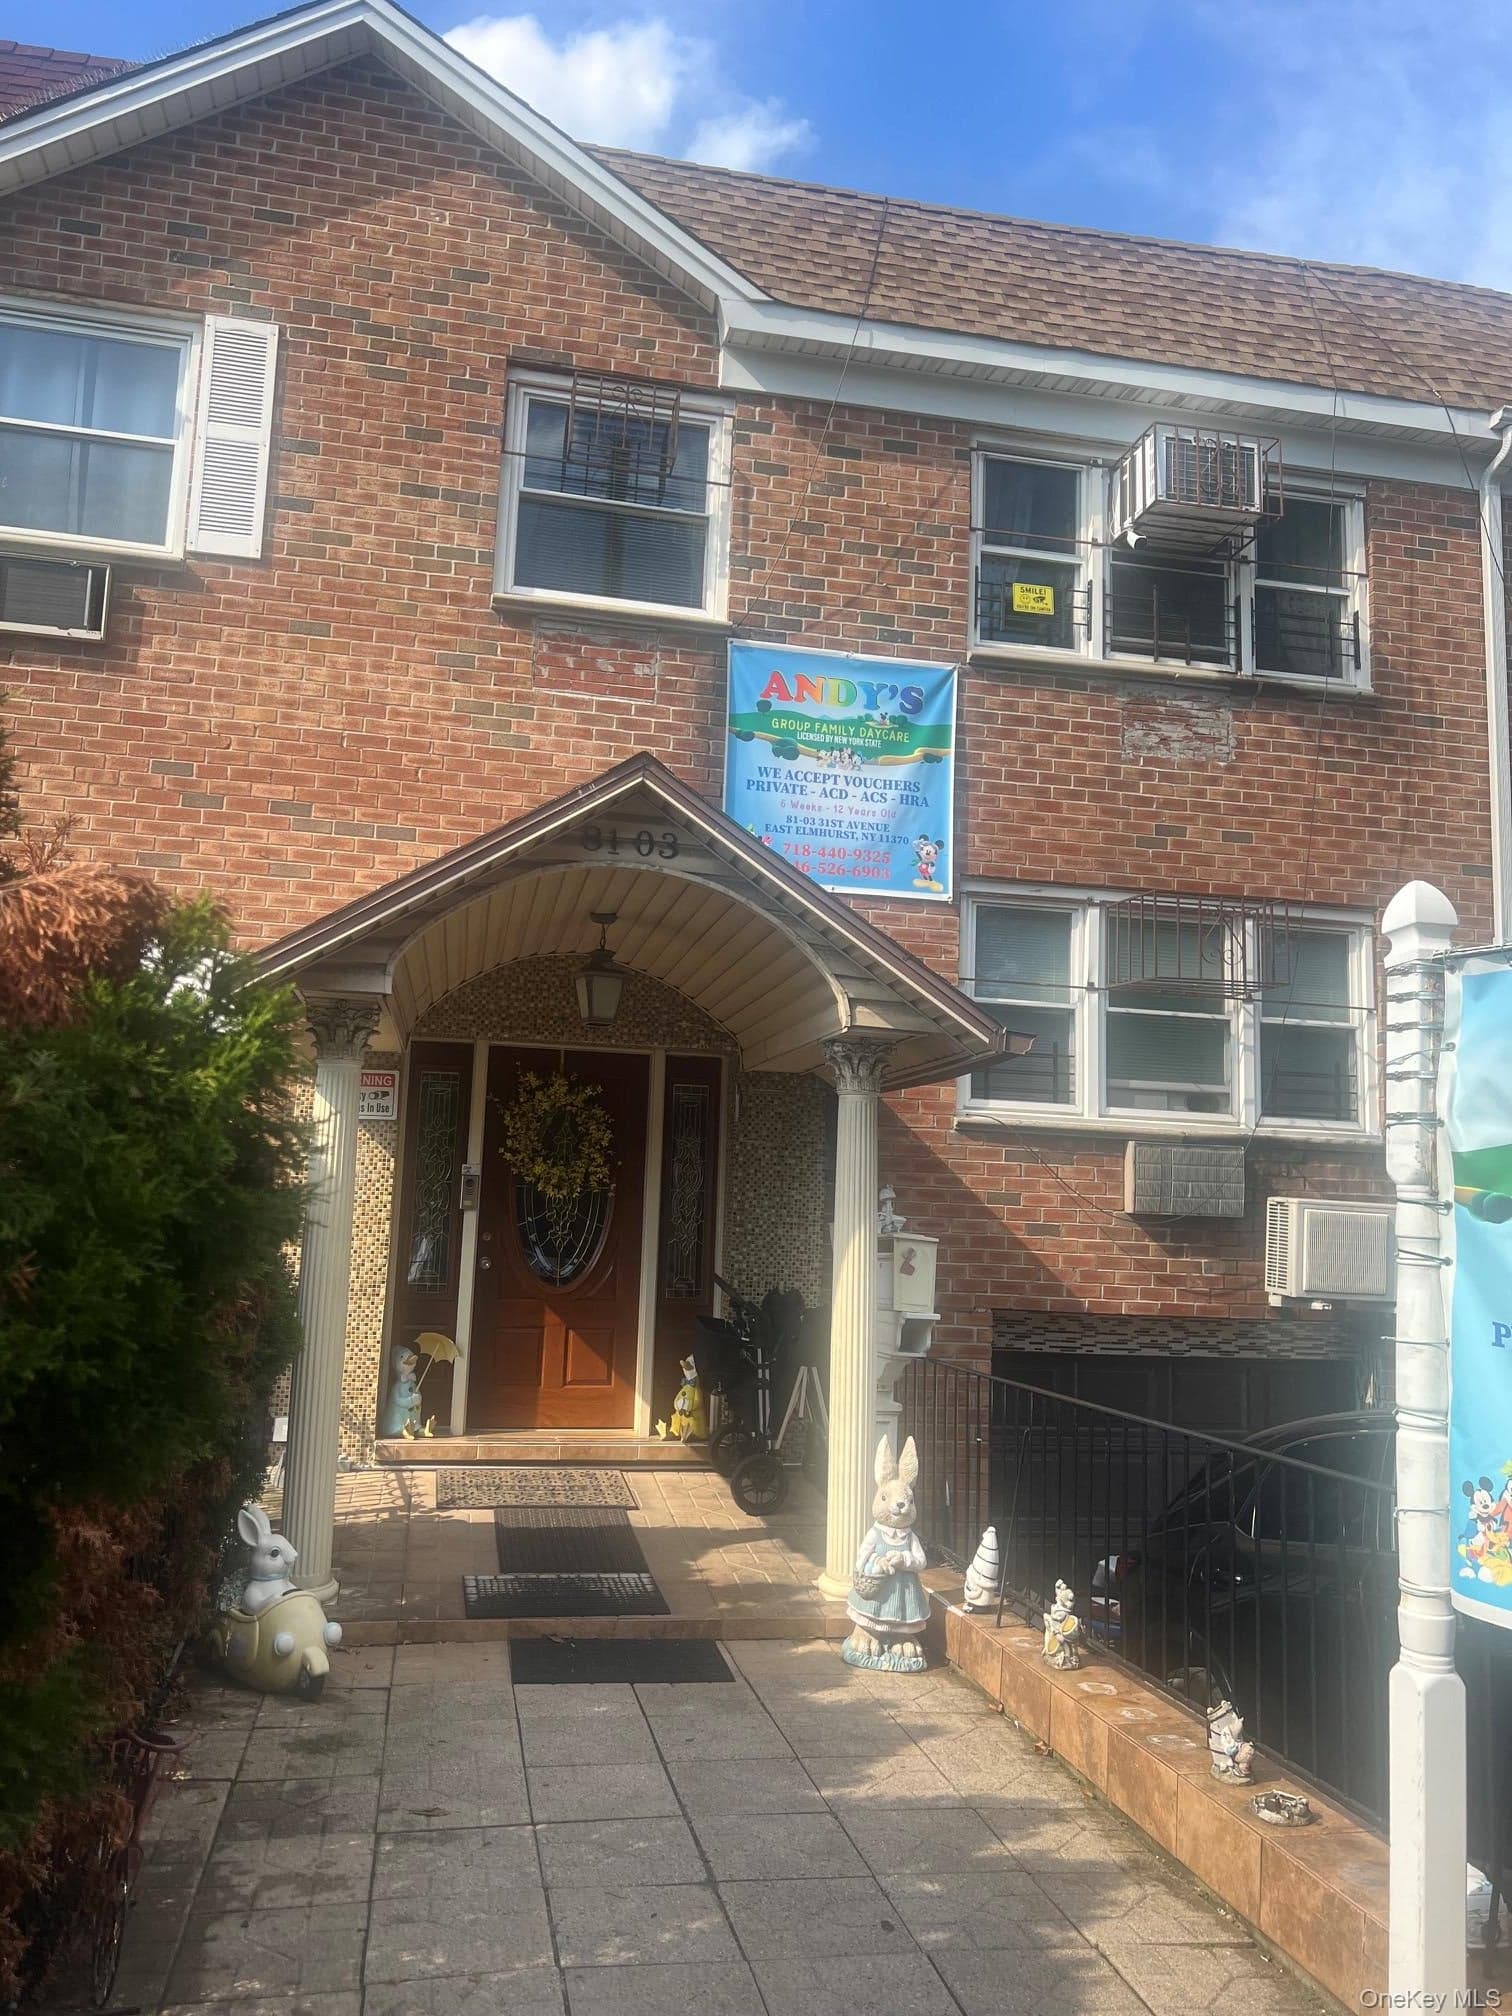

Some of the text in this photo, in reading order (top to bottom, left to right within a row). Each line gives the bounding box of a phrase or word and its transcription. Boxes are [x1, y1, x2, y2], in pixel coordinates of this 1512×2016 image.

[760, 670, 924, 715] ANDY'S
[772, 718, 910, 743] GROUP FAMILY DAYCARE
[797, 732, 882, 748] LICENSED BY NEW YORK STATE
[758, 767, 920, 792] WE ACCEPT VOUCHERS
[746, 779, 808, 796] PRIVATE
[819, 787, 848, 800] ACD
[860, 791, 887, 803] ACS
[900, 794, 929, 808] HRA
[789, 800, 822, 813] Weeks
[834, 805, 845, 814] 12
[848, 806, 877, 818] Years
[881, 808, 897, 819] Old
[765, 824, 909, 845] EAST ELMHURST, NY 11370
[786, 815, 890, 833] 81-03 31ST AVENUE
[783, 843, 892, 865] 718-440-9325
[361, 1075, 392, 1085] NING
[377, 1103, 389, 1113] Use
